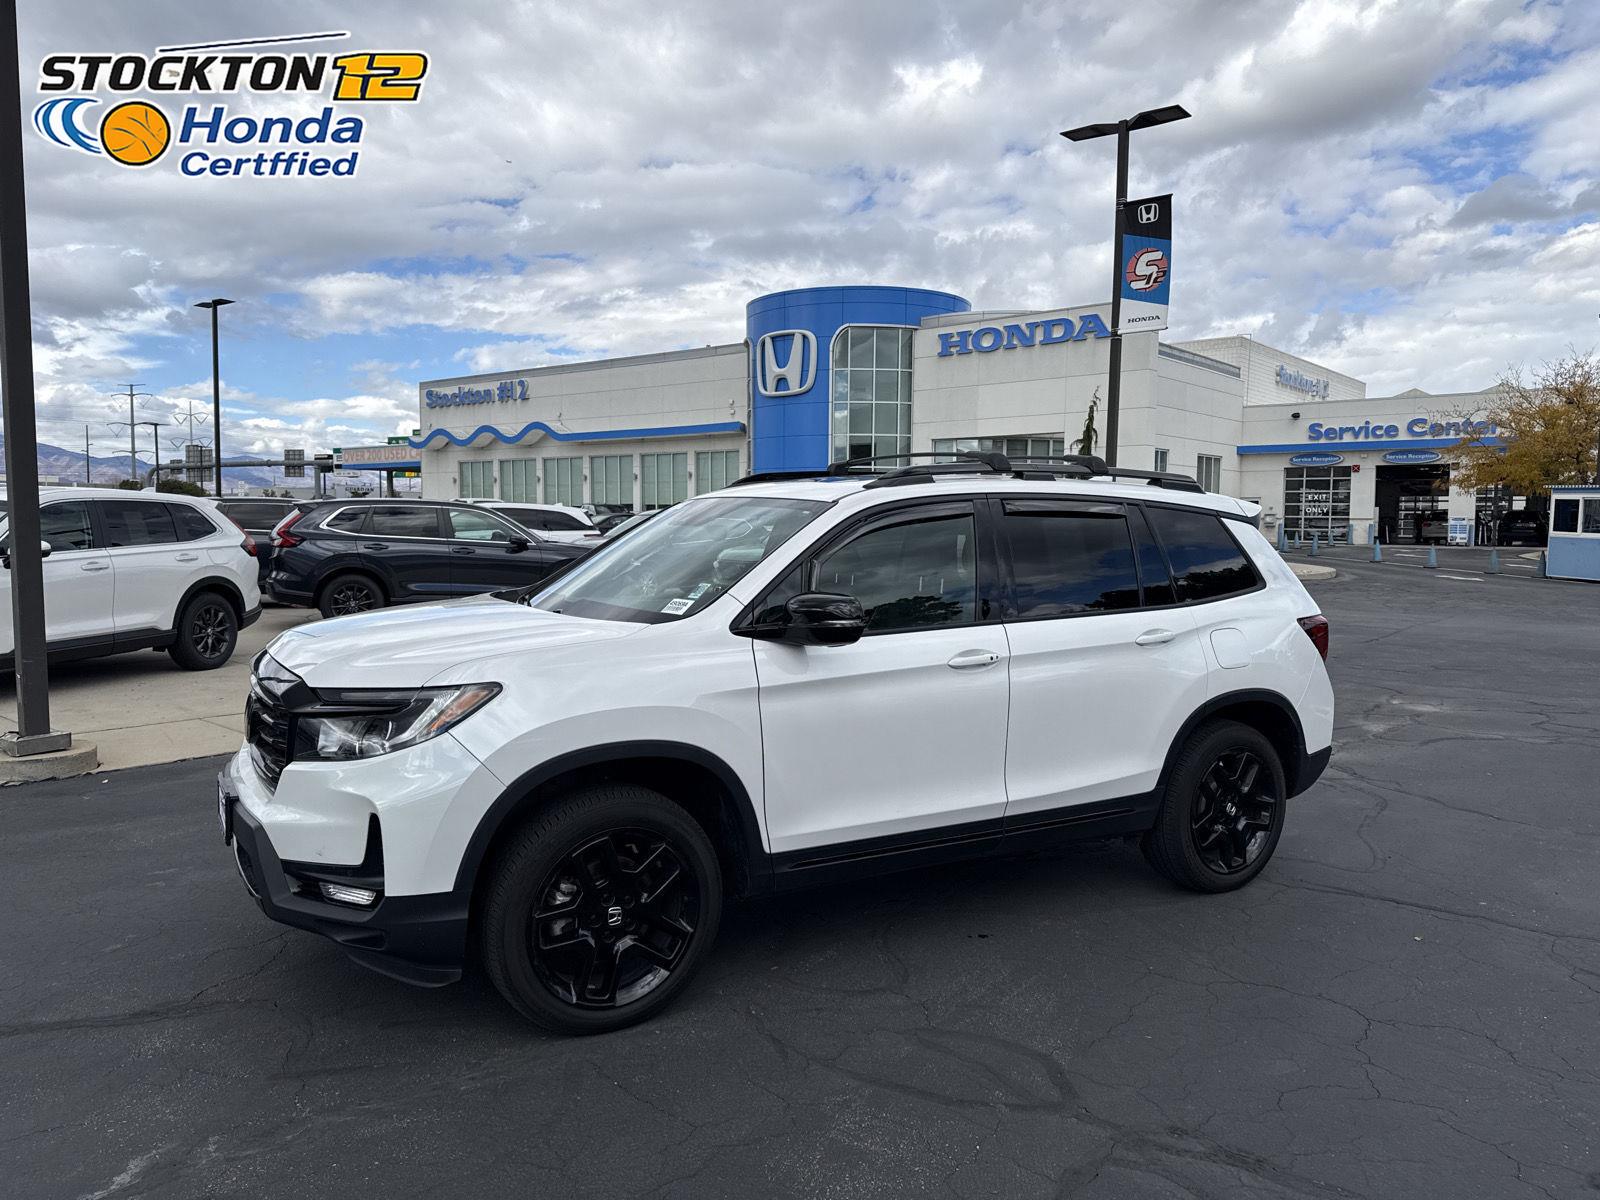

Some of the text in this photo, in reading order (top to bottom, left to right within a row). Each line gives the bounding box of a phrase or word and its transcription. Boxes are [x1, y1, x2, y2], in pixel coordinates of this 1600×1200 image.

[1127, 315, 1161, 323] HONDA
[937, 313, 1112, 357] HONDA
[425, 379, 530, 409] Stockton #12
[1308, 420, 1400, 441] Service
[343, 450, 365, 462] OVER
[367, 449, 384, 461] 200
[385, 447, 407, 460] USED
[1312, 455, 1340, 463] Reception
[1385, 451, 1438, 461] Service Reception
[1305, 506, 1328, 514] ONLY
